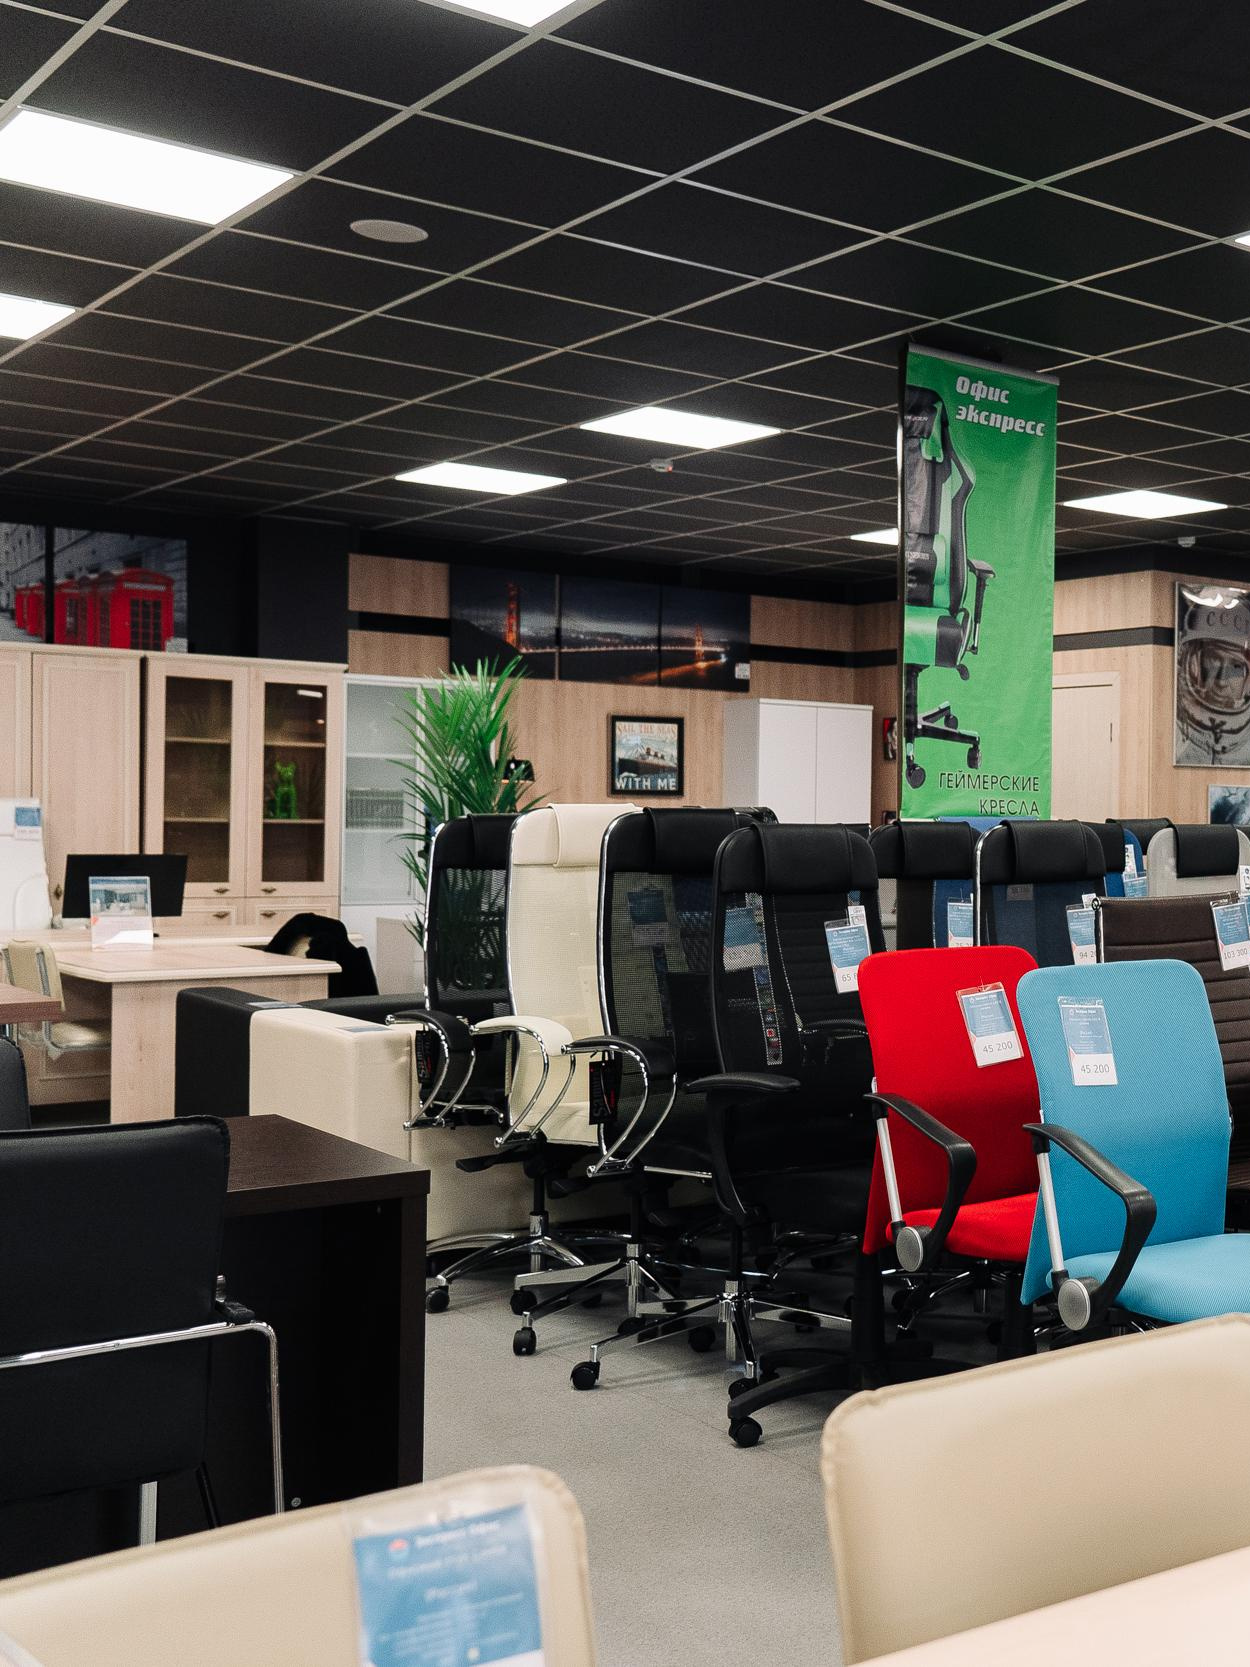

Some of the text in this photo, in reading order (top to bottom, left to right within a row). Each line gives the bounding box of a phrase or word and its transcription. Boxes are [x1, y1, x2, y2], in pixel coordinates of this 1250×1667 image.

[955, 376, 1010, 404] Офис
[955, 404, 1046, 437] экспресс
[615, 777, 677, 791] WITH ME
[939, 770, 1040, 792] ГЕЙМЕРСКИЕ
[979, 799, 1040, 816] КРЕСЛА
[982, 1040, 1013, 1054] 45 200
[1080, 1064, 1110, 1074] 45 200
